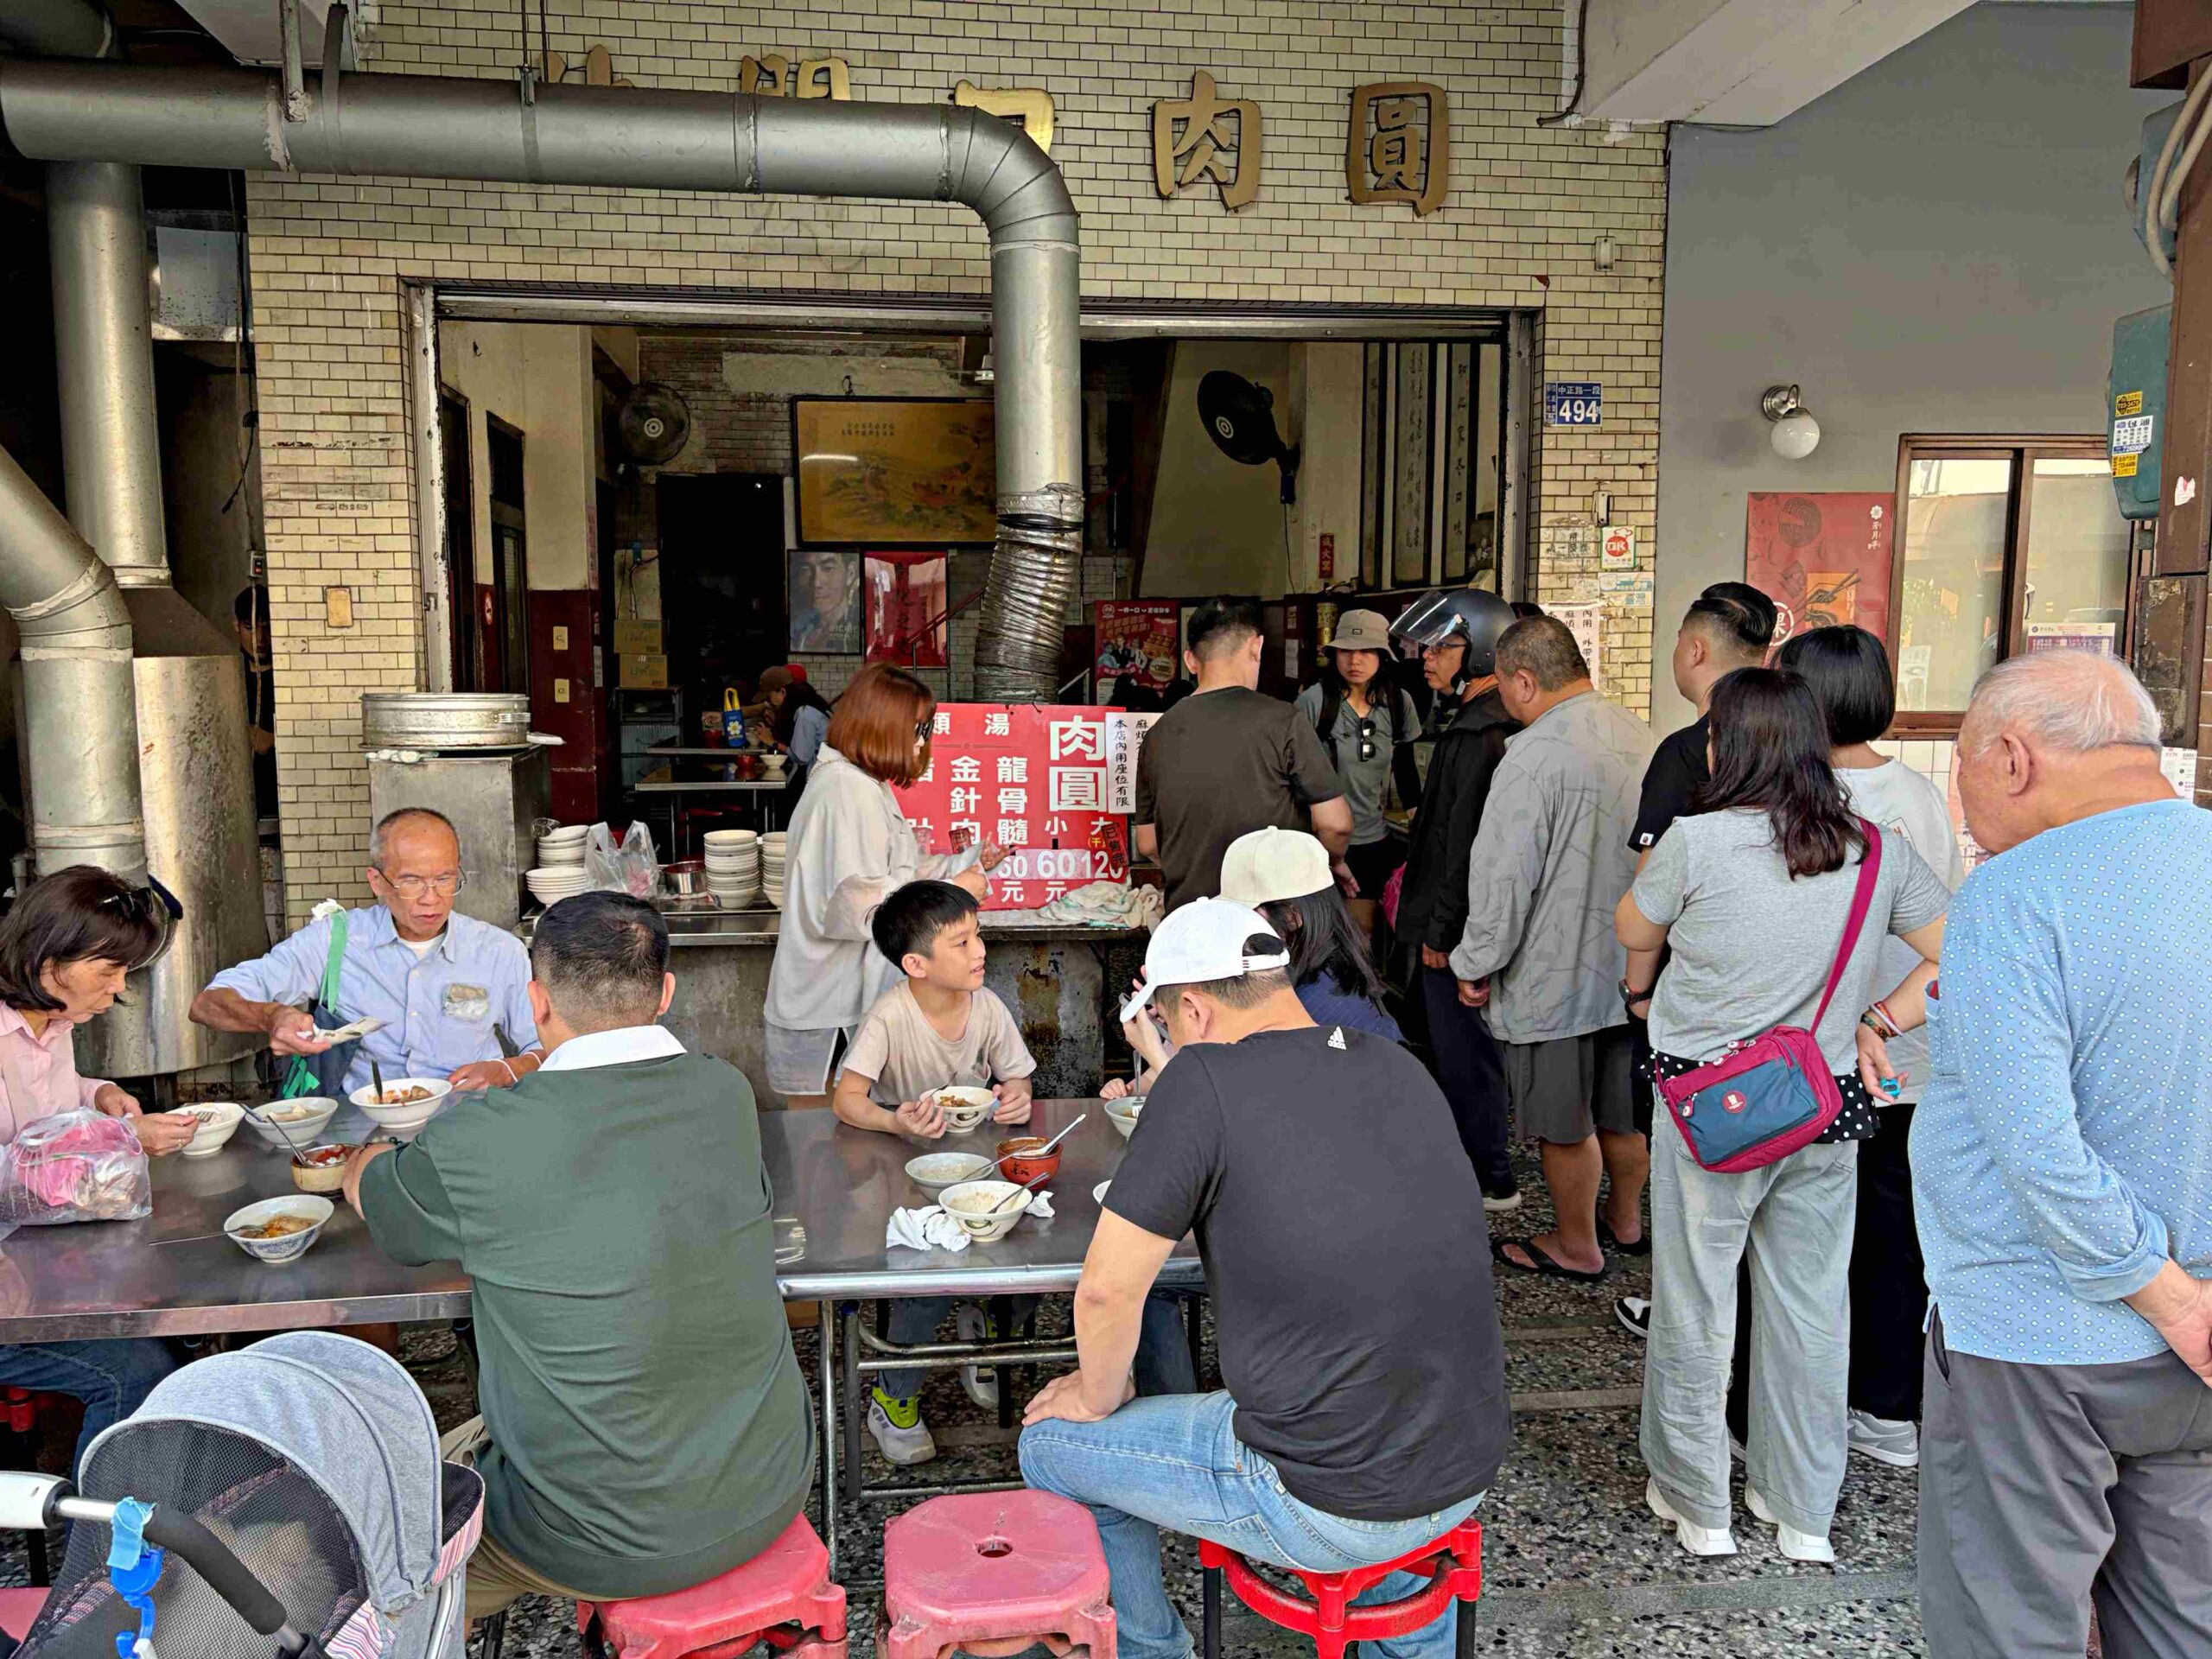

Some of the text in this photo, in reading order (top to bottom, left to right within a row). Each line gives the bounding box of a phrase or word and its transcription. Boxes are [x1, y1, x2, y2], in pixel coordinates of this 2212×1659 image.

[1559, 399, 1599, 423] 494
[1049, 715, 1107, 812] 肉圓
[1114, 719, 1130, 807] 本店內用座位有限
[996, 756, 1029, 846] 龍骨髓
[1045, 817, 1068, 836] 小
[1037, 850, 1076, 878] 60
[1001, 880, 1025, 903] 元
